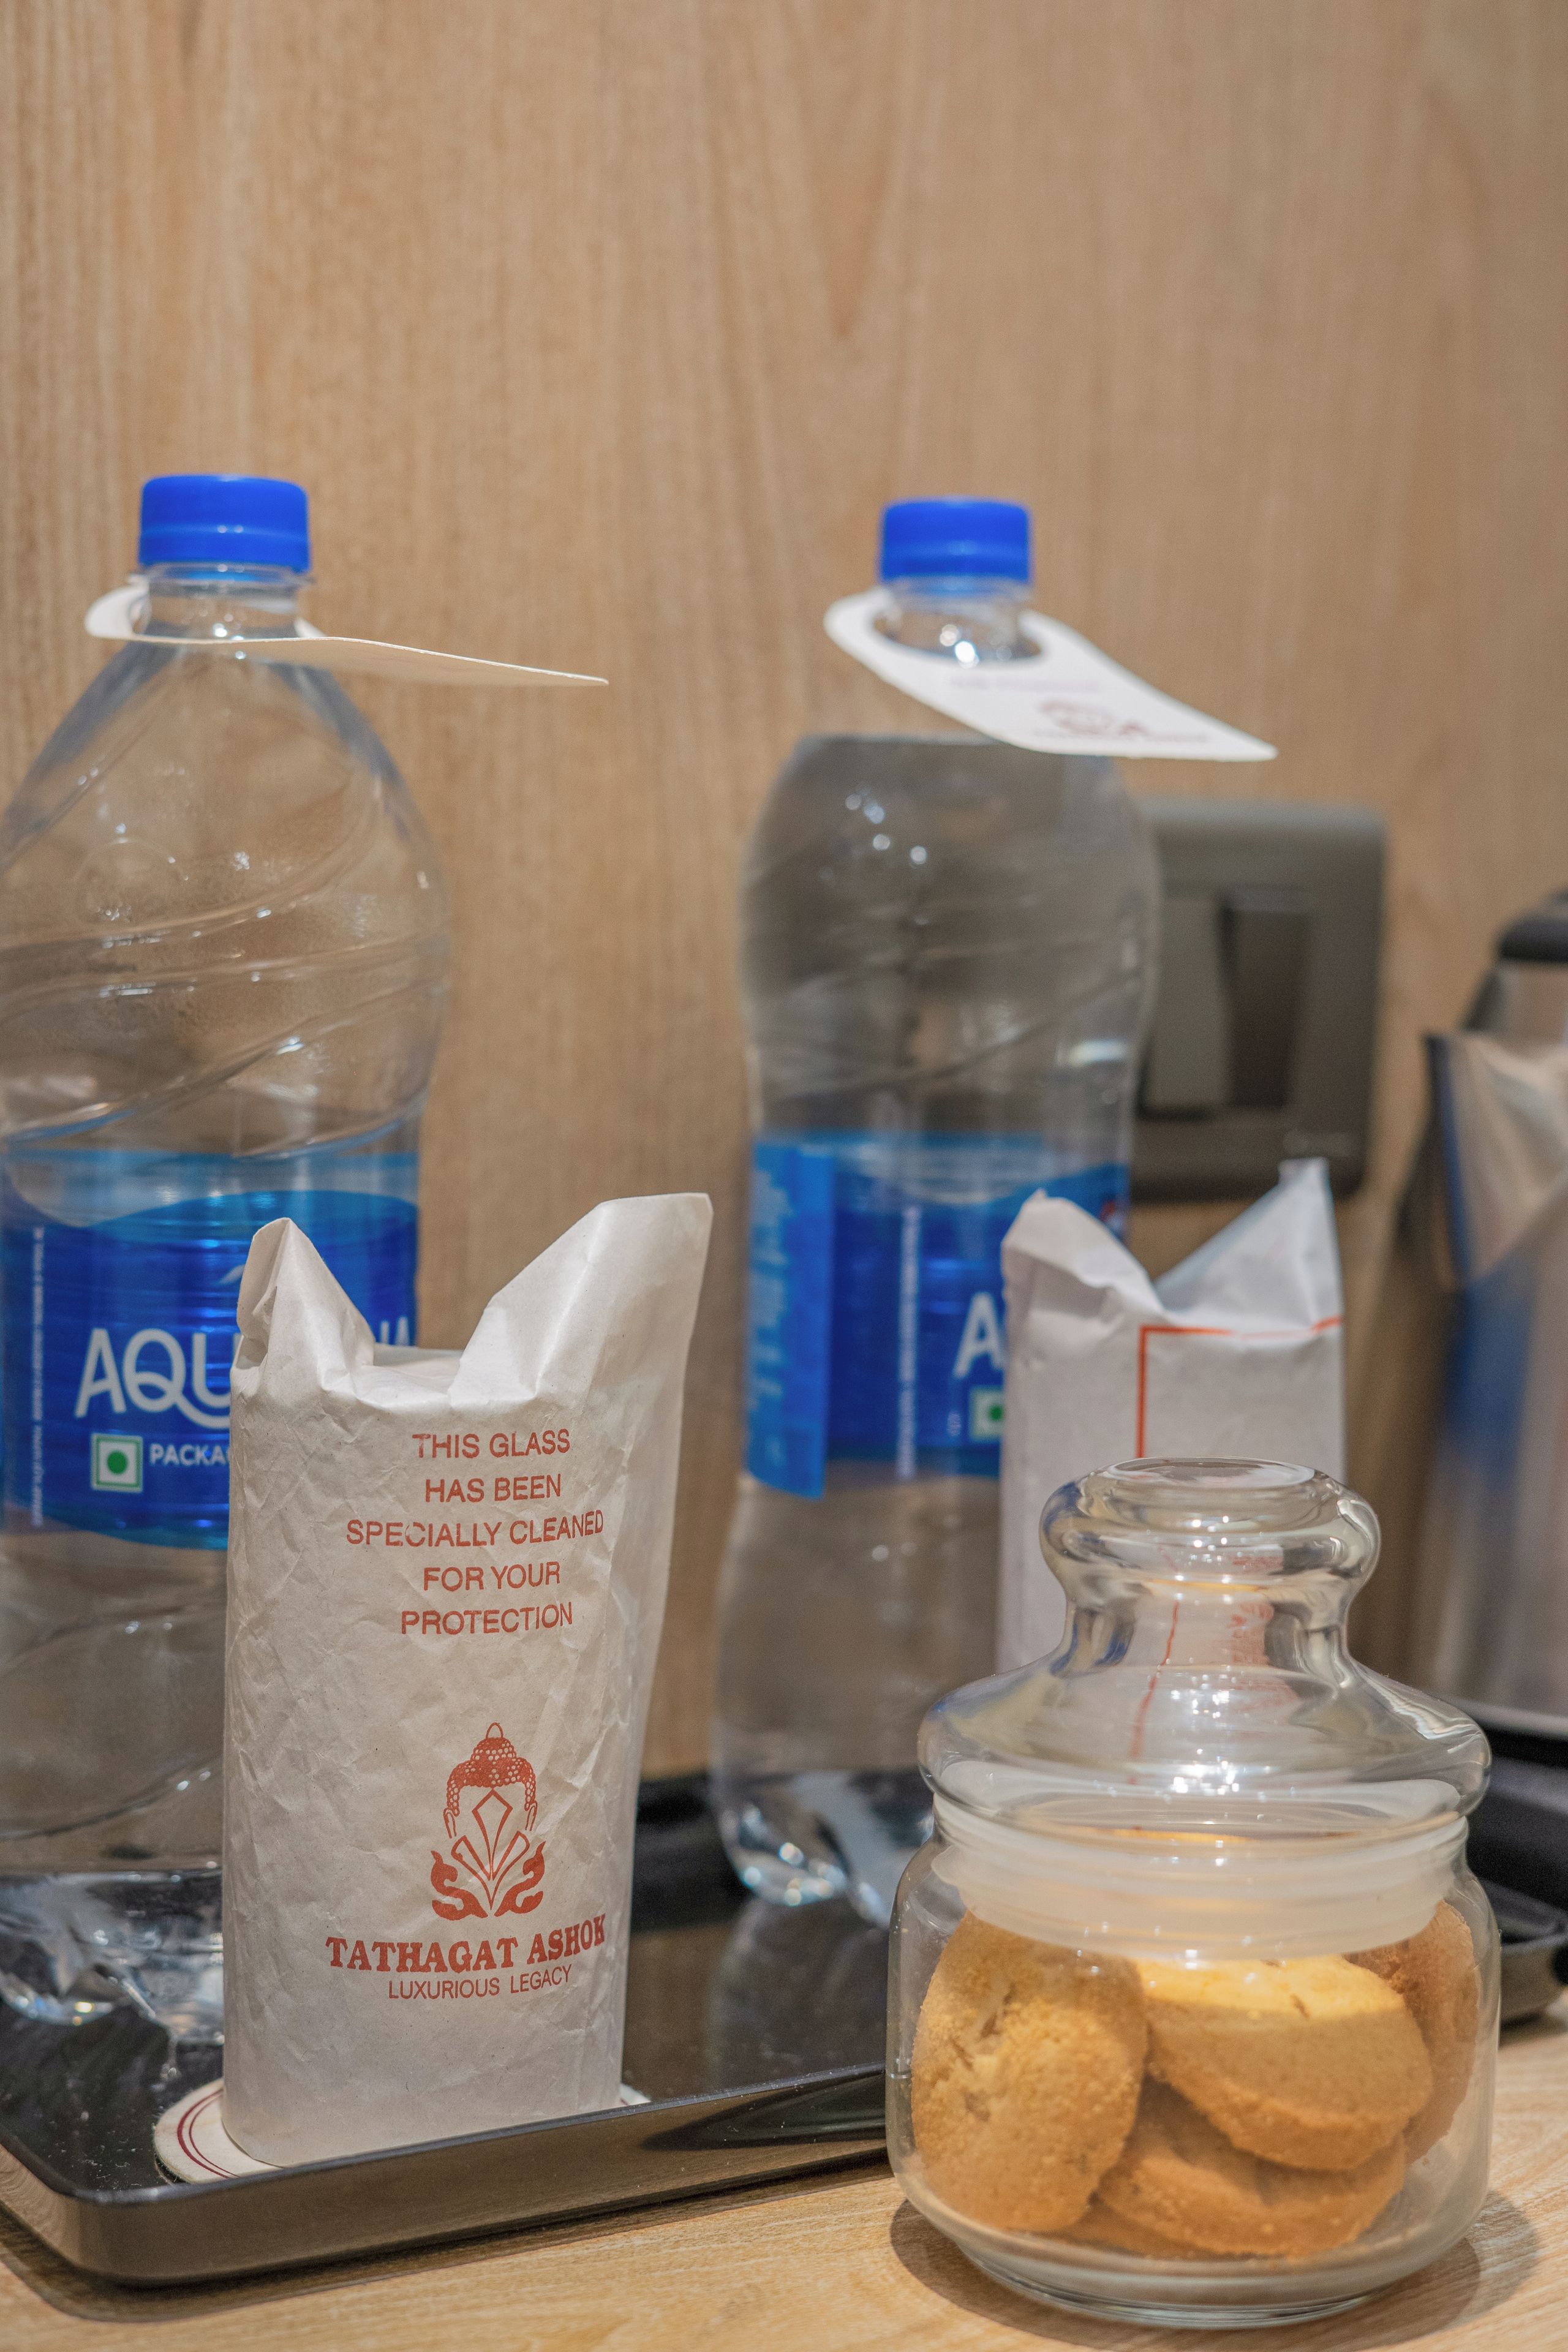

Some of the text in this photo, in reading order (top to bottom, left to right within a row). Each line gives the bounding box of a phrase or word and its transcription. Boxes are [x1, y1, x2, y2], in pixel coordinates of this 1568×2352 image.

[149, 1442, 230, 1466] PACKA
[412, 1428, 571, 1459] THIS GLASS
[425, 1473, 562, 1504] HAS BEEN
[346, 1509, 604, 1548] SPECIALLY CLEANED
[423, 1561, 560, 1592] FOR YOUR
[401, 1601, 573, 1635] PROTECTION
[325, 1913, 606, 1973] TATHAGAT ASHOK
[388, 1964, 573, 2000] LUXURIOUS LEGACY
